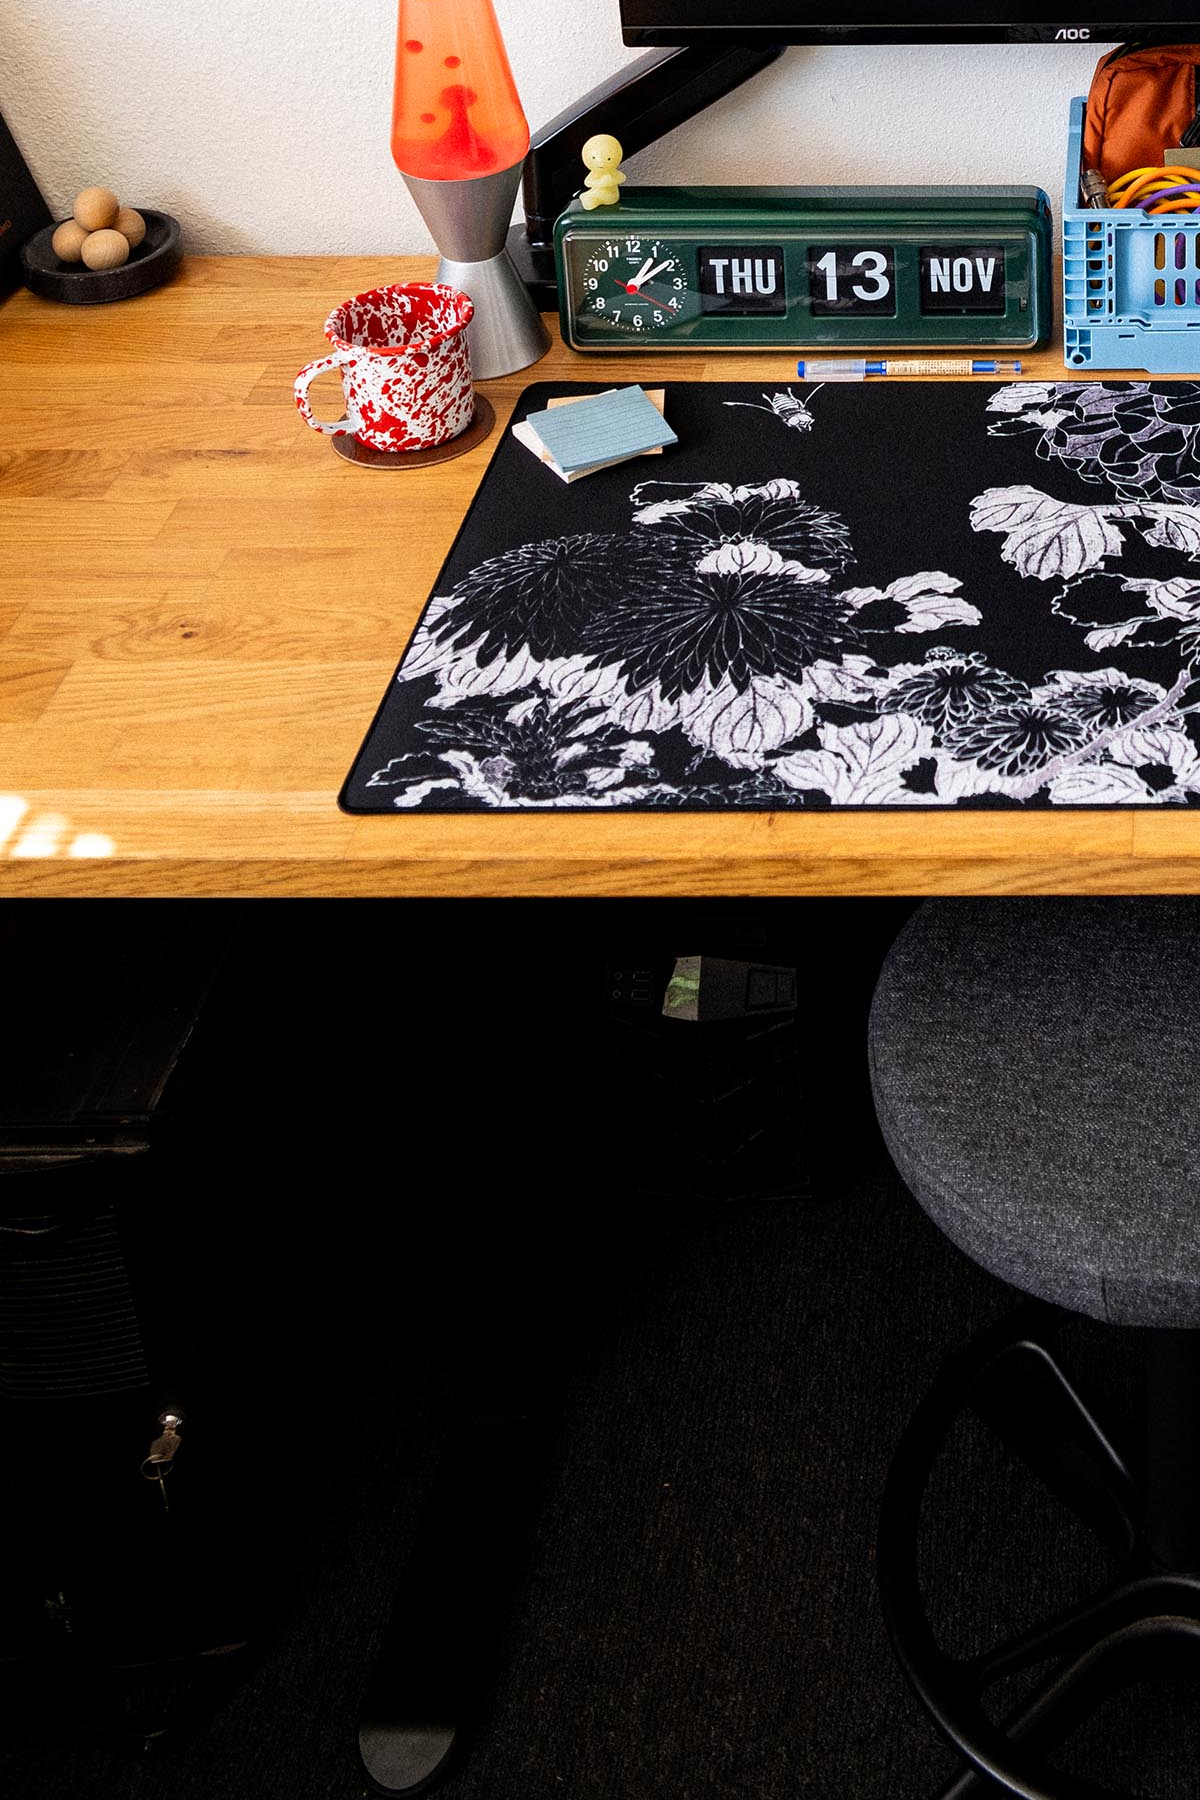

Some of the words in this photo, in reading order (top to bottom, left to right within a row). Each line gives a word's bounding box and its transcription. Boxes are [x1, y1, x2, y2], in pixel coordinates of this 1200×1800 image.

[1055, 28, 1090, 40] AOC
[606, 245, 619, 258] 11
[626, 240, 641, 253] 12
[651, 245, 658, 258] 1
[593, 259, 609, 272] 10
[666, 259, 675, 272] 2
[709, 258, 776, 294] THU
[816, 250, 890, 301] 13
[930, 257, 996, 293] NOV
[588, 278, 598, 290] 9
[672, 278, 683, 290] 3
[595, 297, 606, 309] 8
[668, 297, 678, 309] 4
[612, 310, 621, 322] 7
[632, 315, 643, 327] 6
[653, 310, 663, 322] 5
